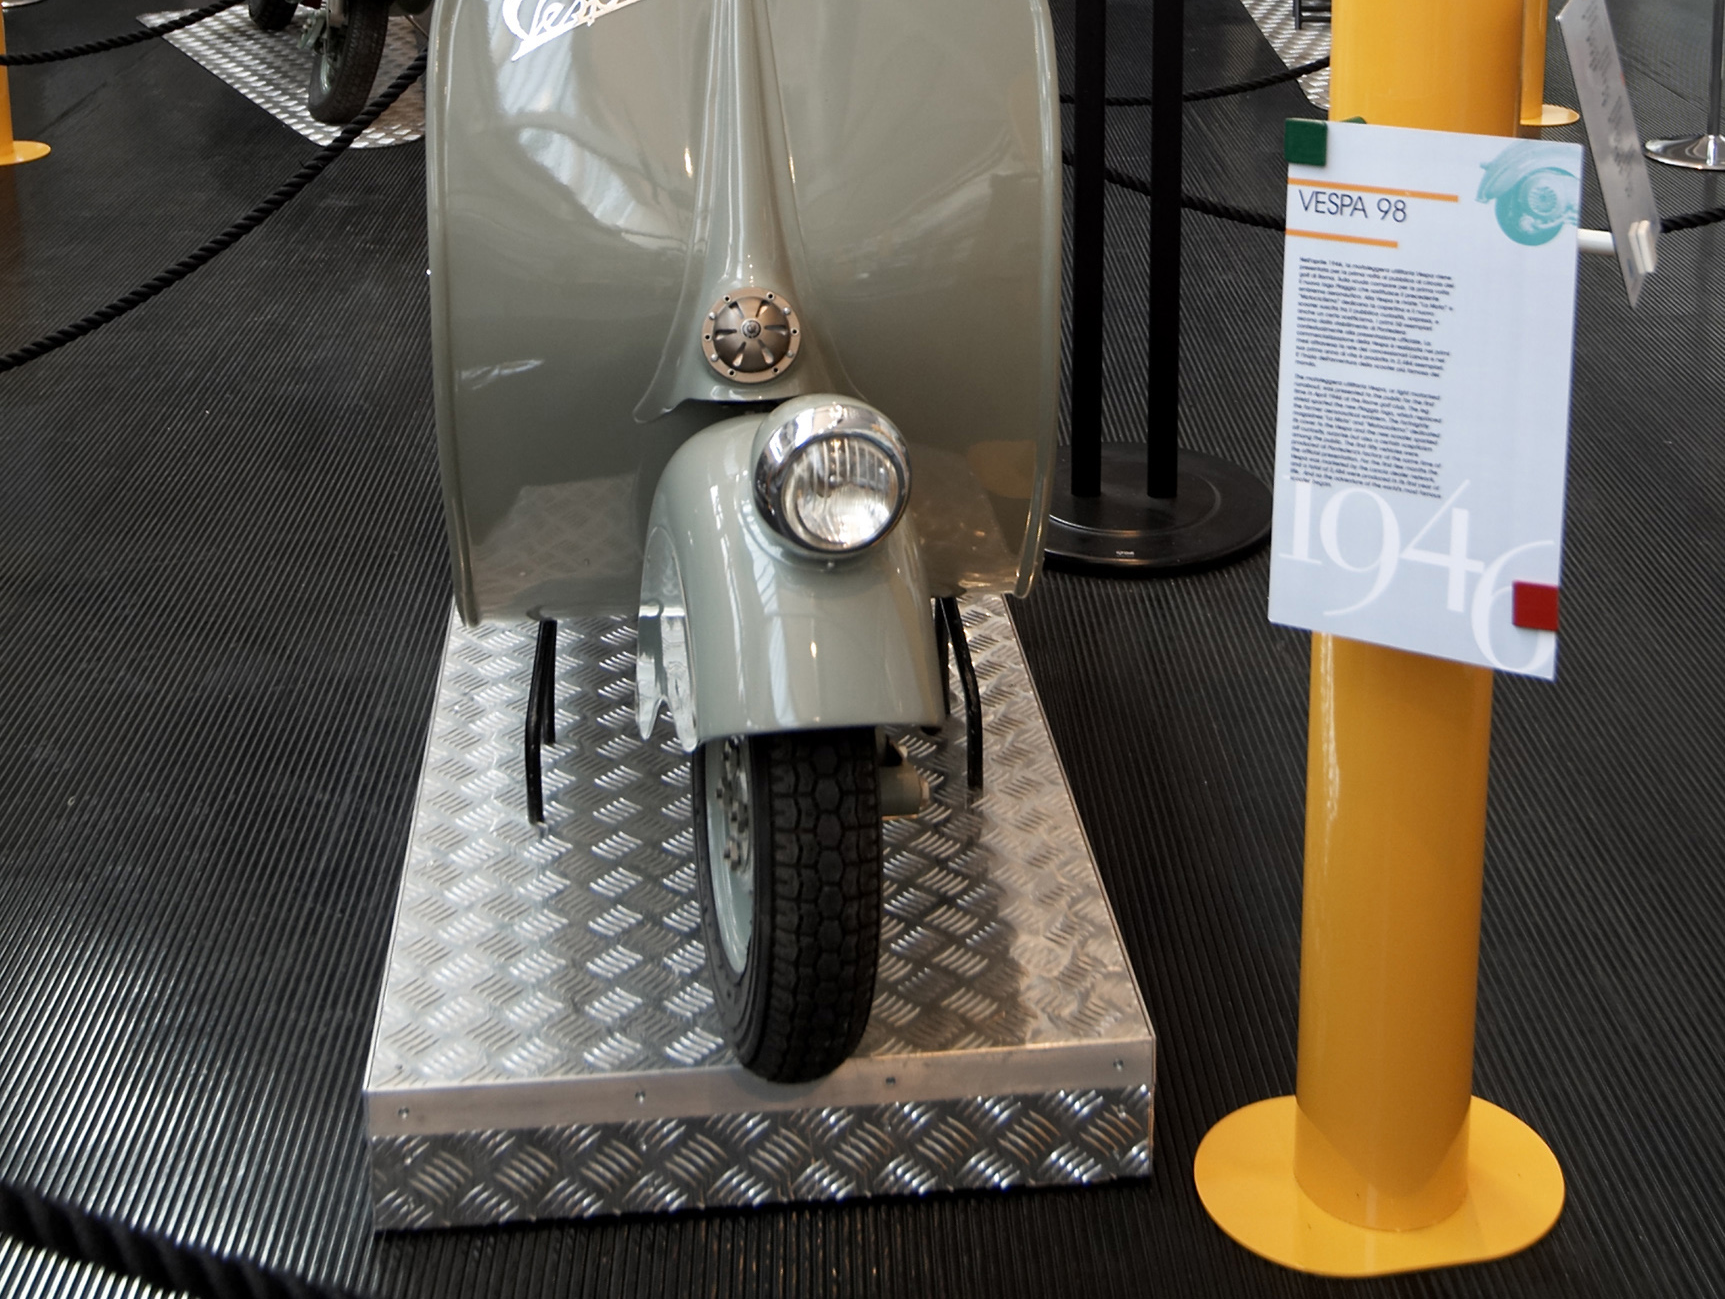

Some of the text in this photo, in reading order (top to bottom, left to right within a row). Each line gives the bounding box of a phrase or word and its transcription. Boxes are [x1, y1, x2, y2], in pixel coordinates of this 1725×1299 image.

[1298, 189, 1406, 222] VESPA 98
[1278, 474, 1556, 674] 1946
